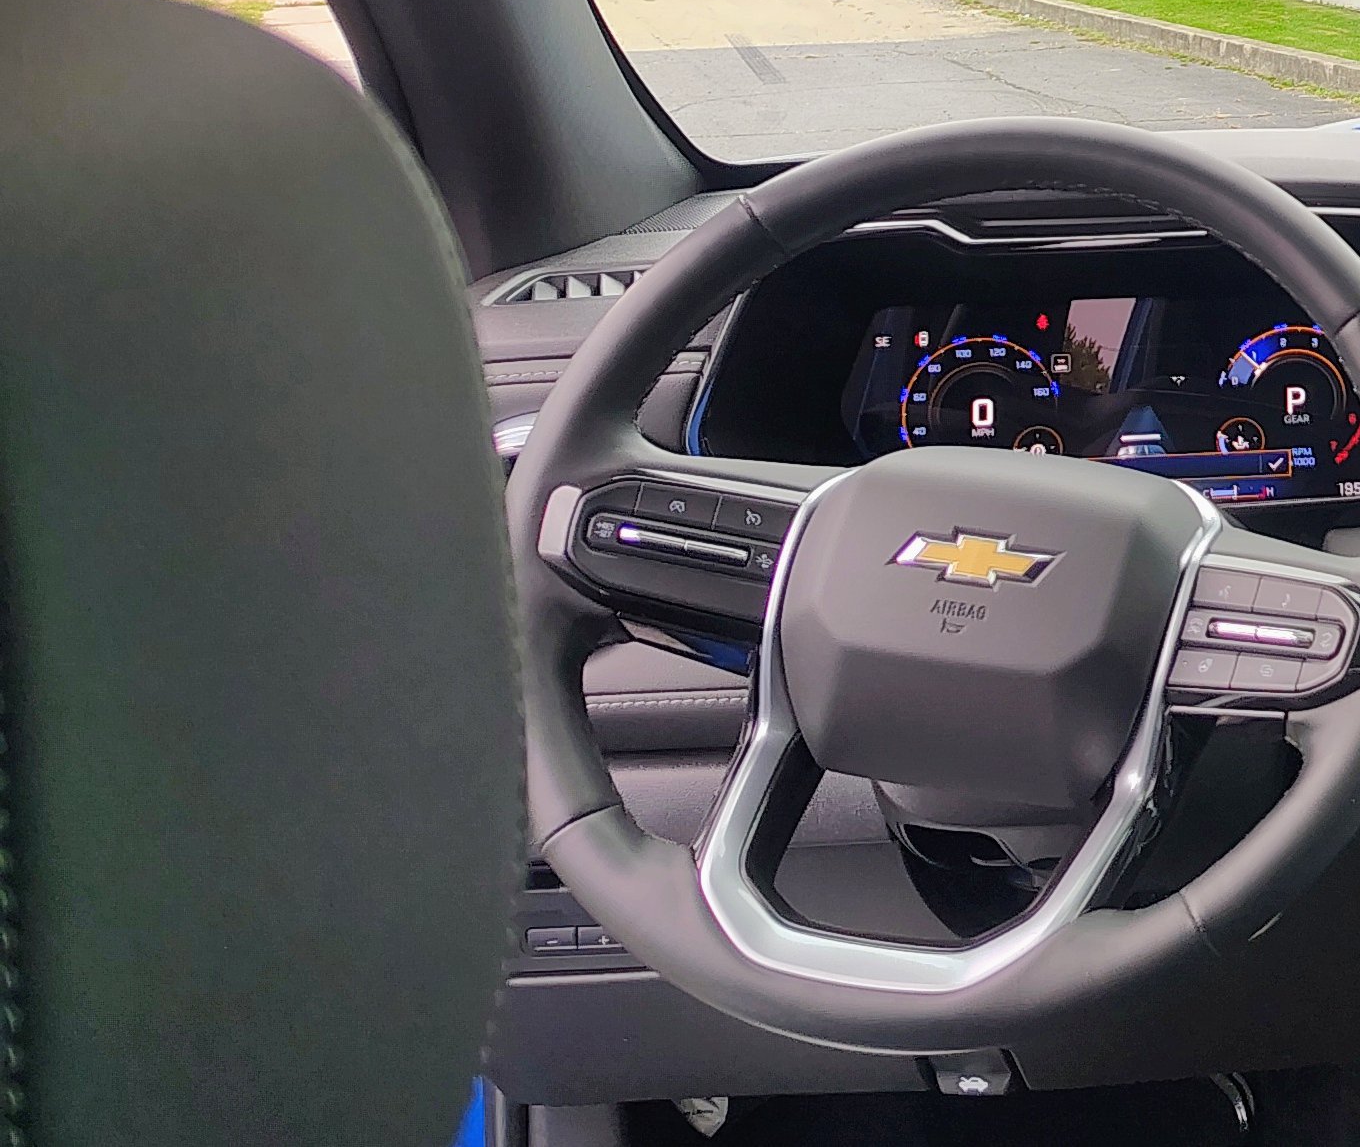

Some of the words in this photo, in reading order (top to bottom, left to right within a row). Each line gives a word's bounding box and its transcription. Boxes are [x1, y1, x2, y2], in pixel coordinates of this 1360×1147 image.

[875, 336, 892, 348] SE
[1286, 386, 1306, 415] P
[971, 398, 994, 428] 0
[1283, 414, 1310, 425] GEAR
[971, 428, 994, 438] MPH
[1291, 447, 1313, 456] RPM
[930, 599, 986, 621] AIRBAG
